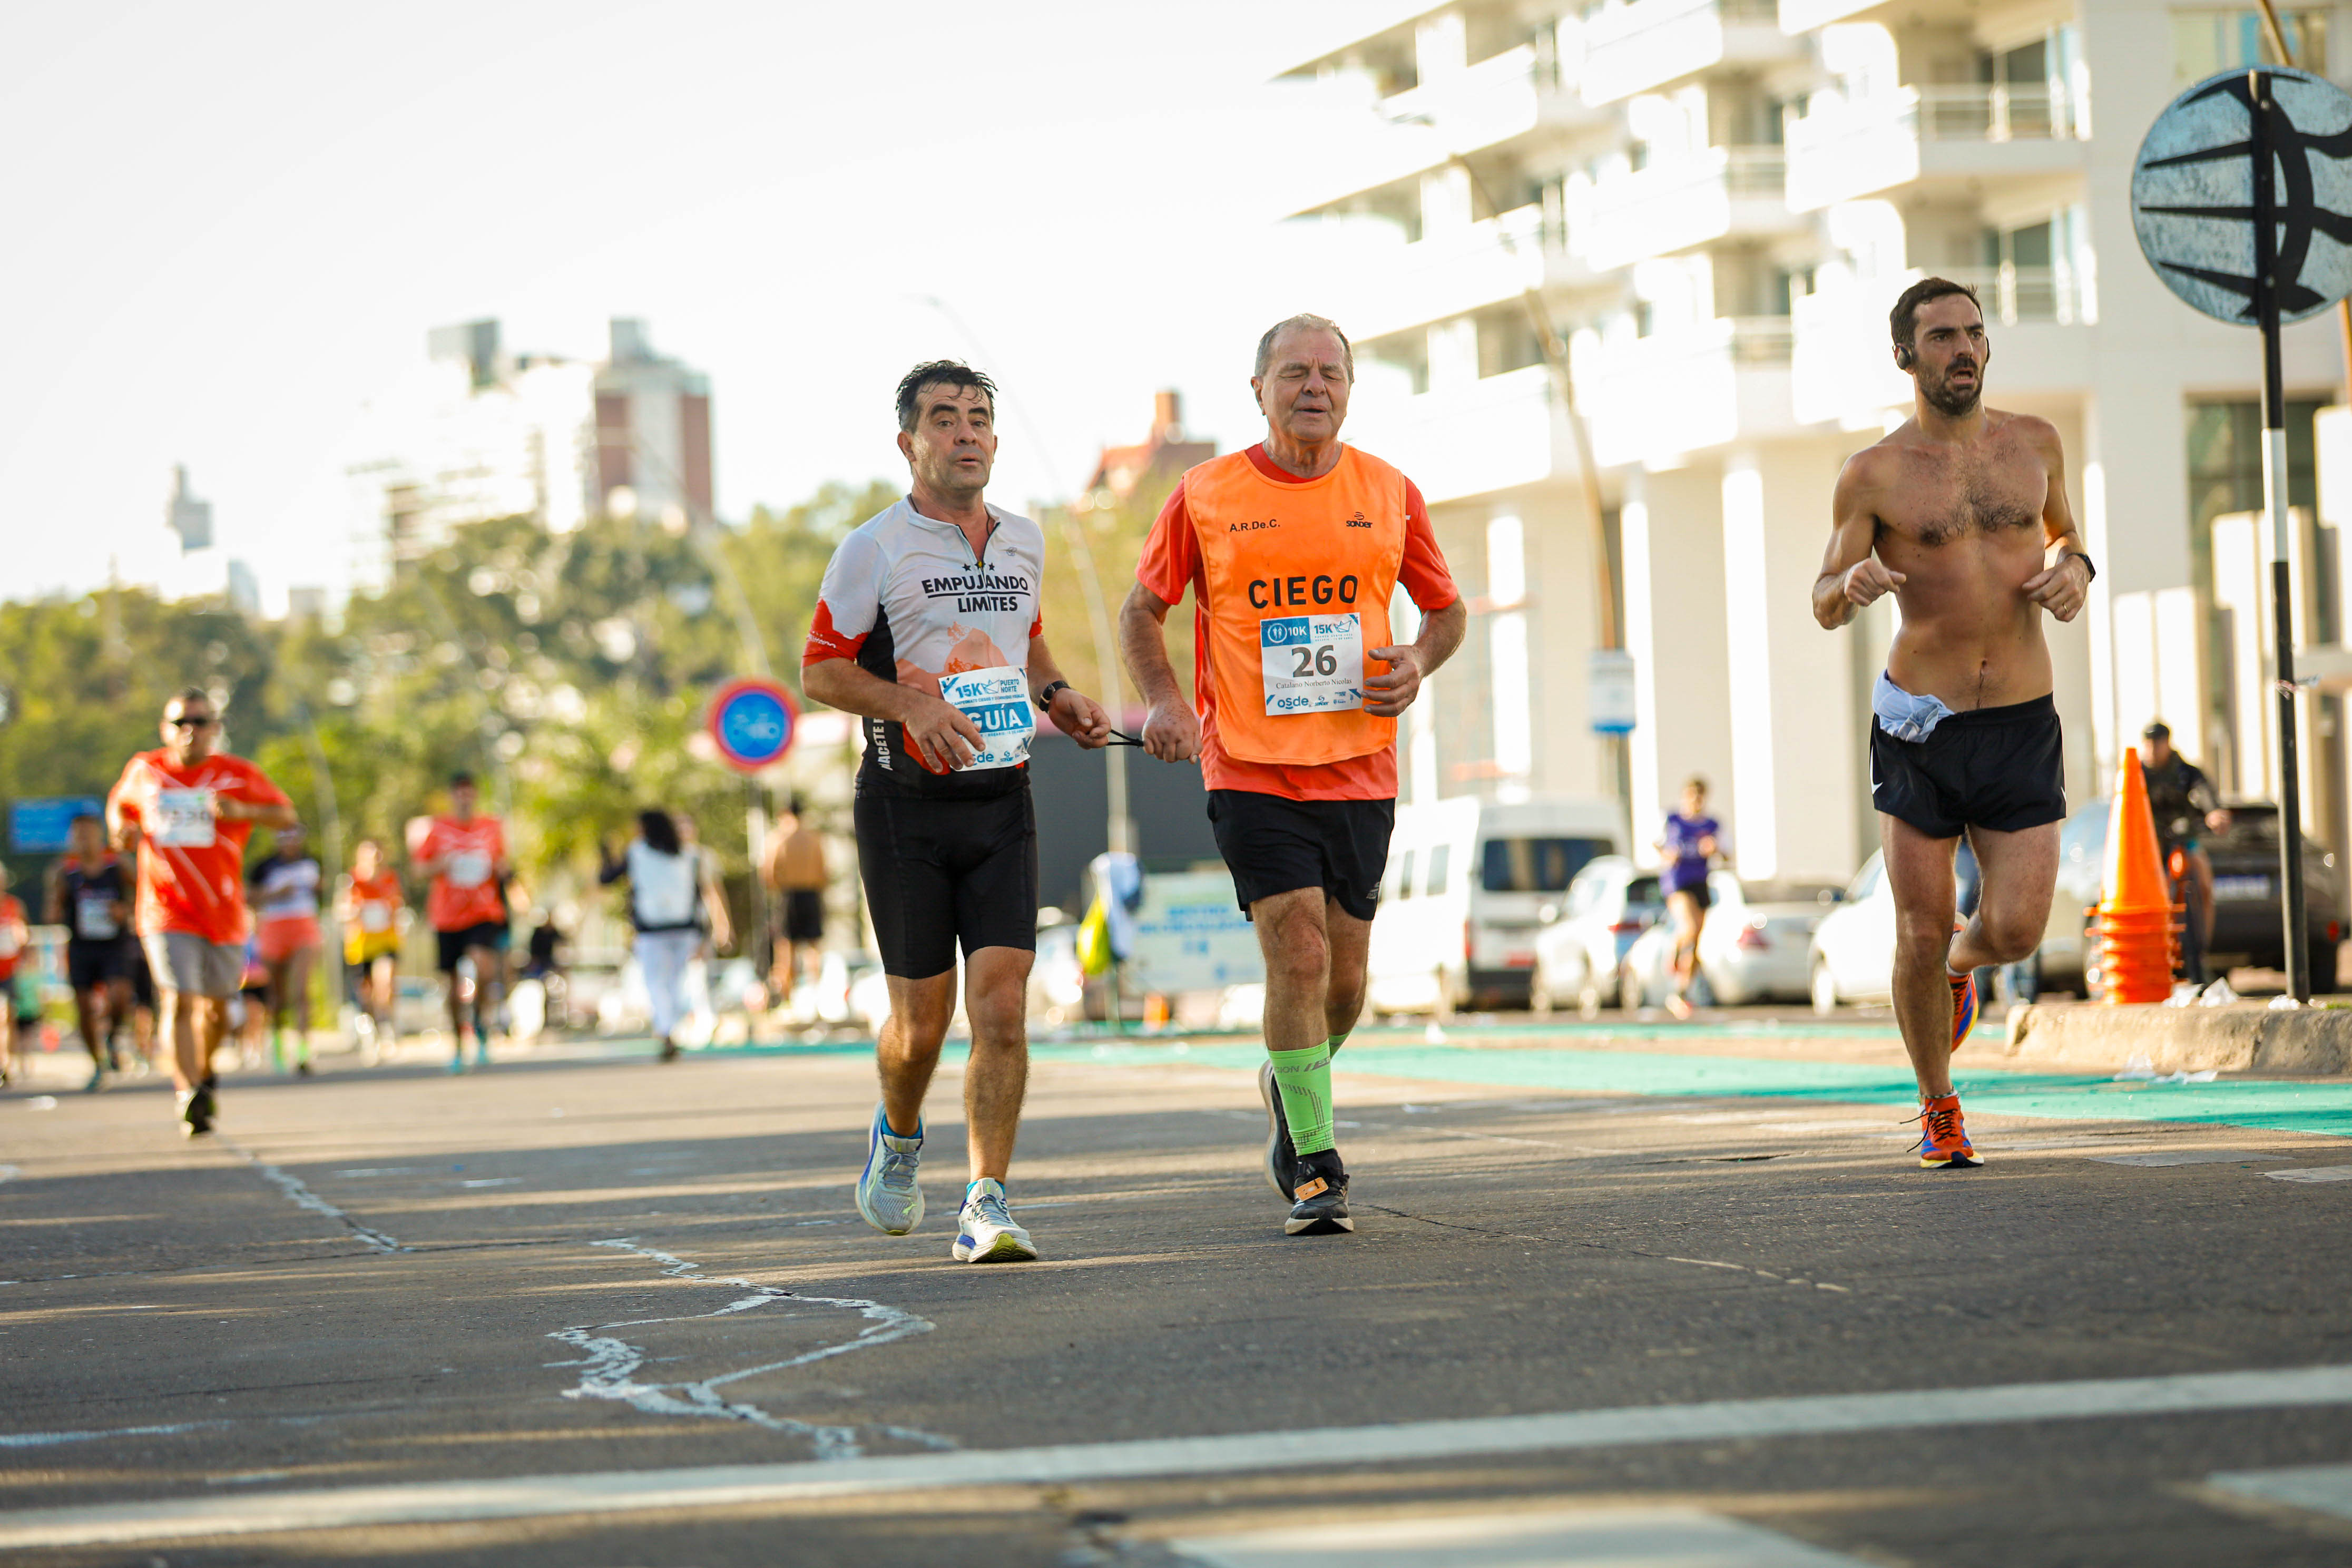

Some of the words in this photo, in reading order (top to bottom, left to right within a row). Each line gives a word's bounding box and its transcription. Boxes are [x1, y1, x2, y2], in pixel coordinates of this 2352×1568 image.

[1229, 518, 1280, 532] A.R.De.C.
[921, 574, 1028, 594] EMPUJANDO
[1248, 575, 1358, 609] CIEGO
[1288, 625, 1307, 636] 10K
[1314, 624, 1333, 634] 15K
[1291, 644, 1337, 678] 26
[956, 683, 983, 698] 15K
[1277, 695, 1309, 709] osde
[967, 704, 1024, 730] GUÍA
